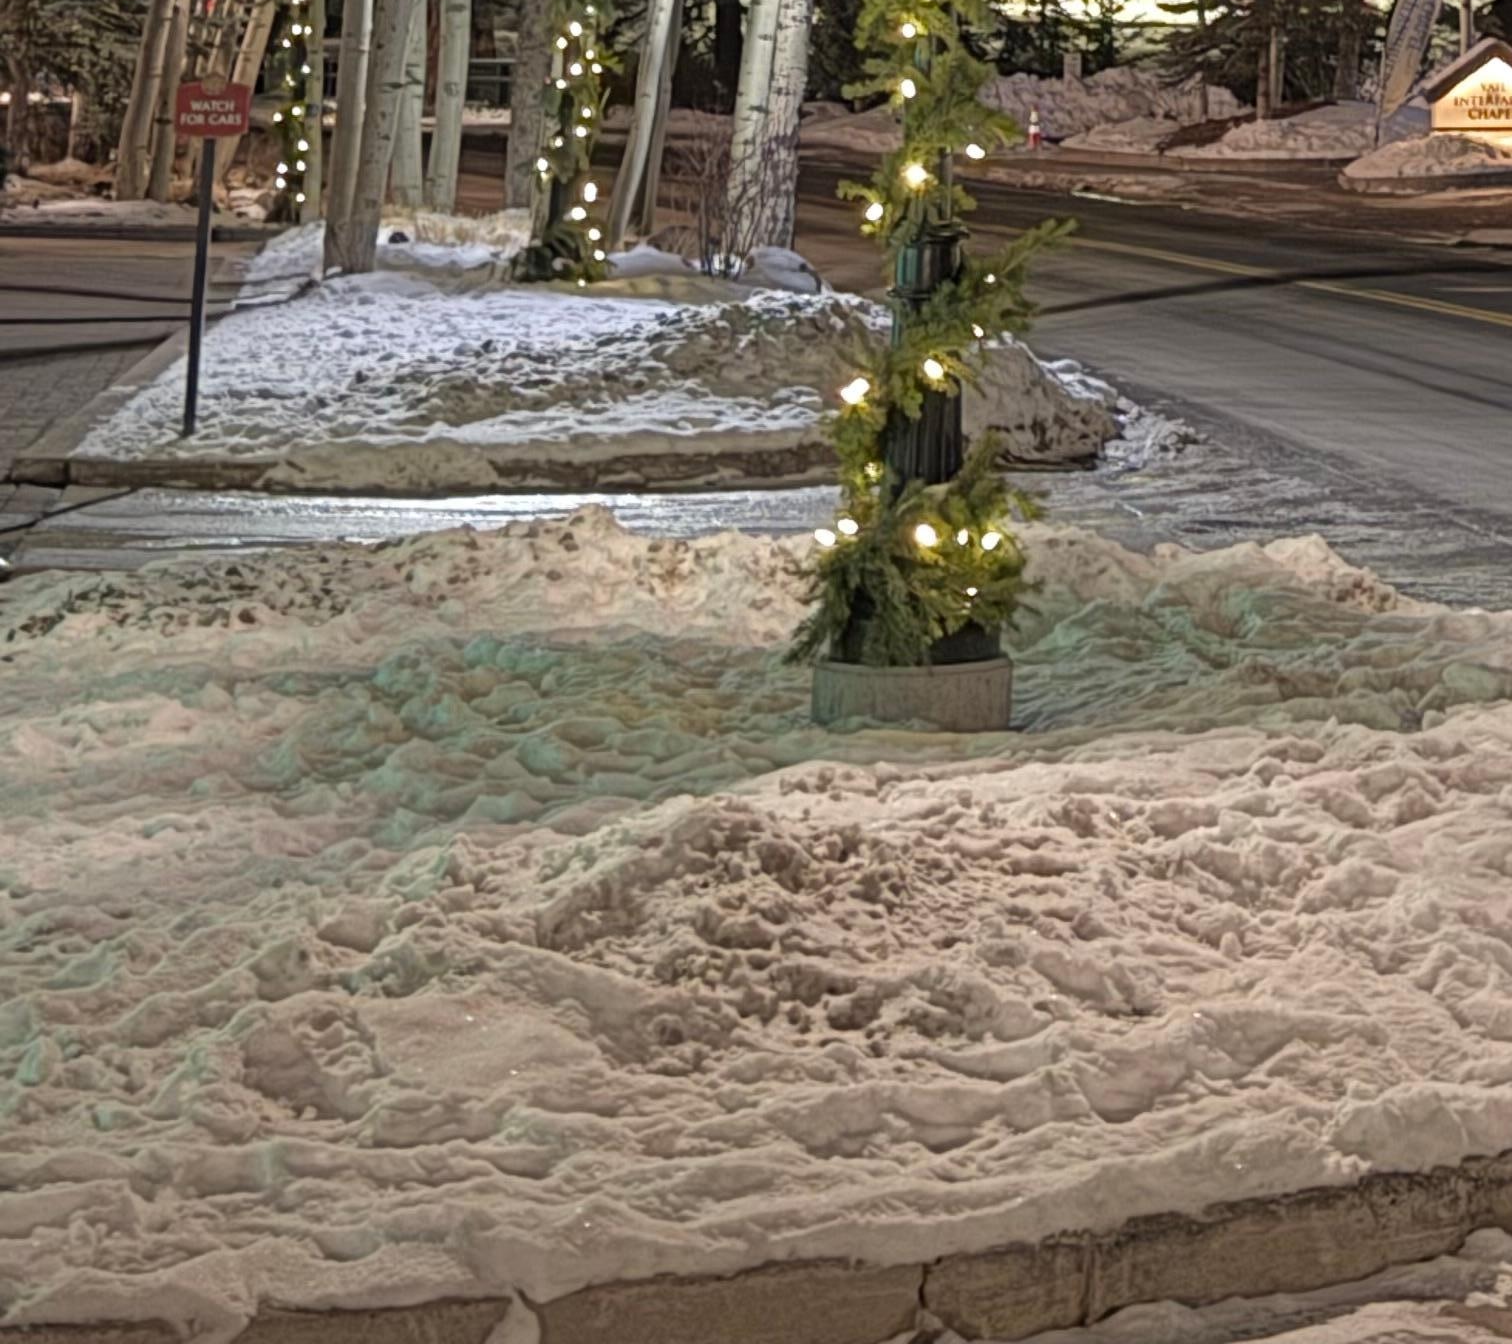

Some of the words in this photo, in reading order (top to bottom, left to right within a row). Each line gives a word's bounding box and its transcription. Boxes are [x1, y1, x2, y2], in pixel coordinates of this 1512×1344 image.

[1480, 81, 1506, 93] VAIL
[190, 99, 236, 112] WATCH
[180, 113, 206, 125] FOR
[207, 113, 242, 125] CARS
